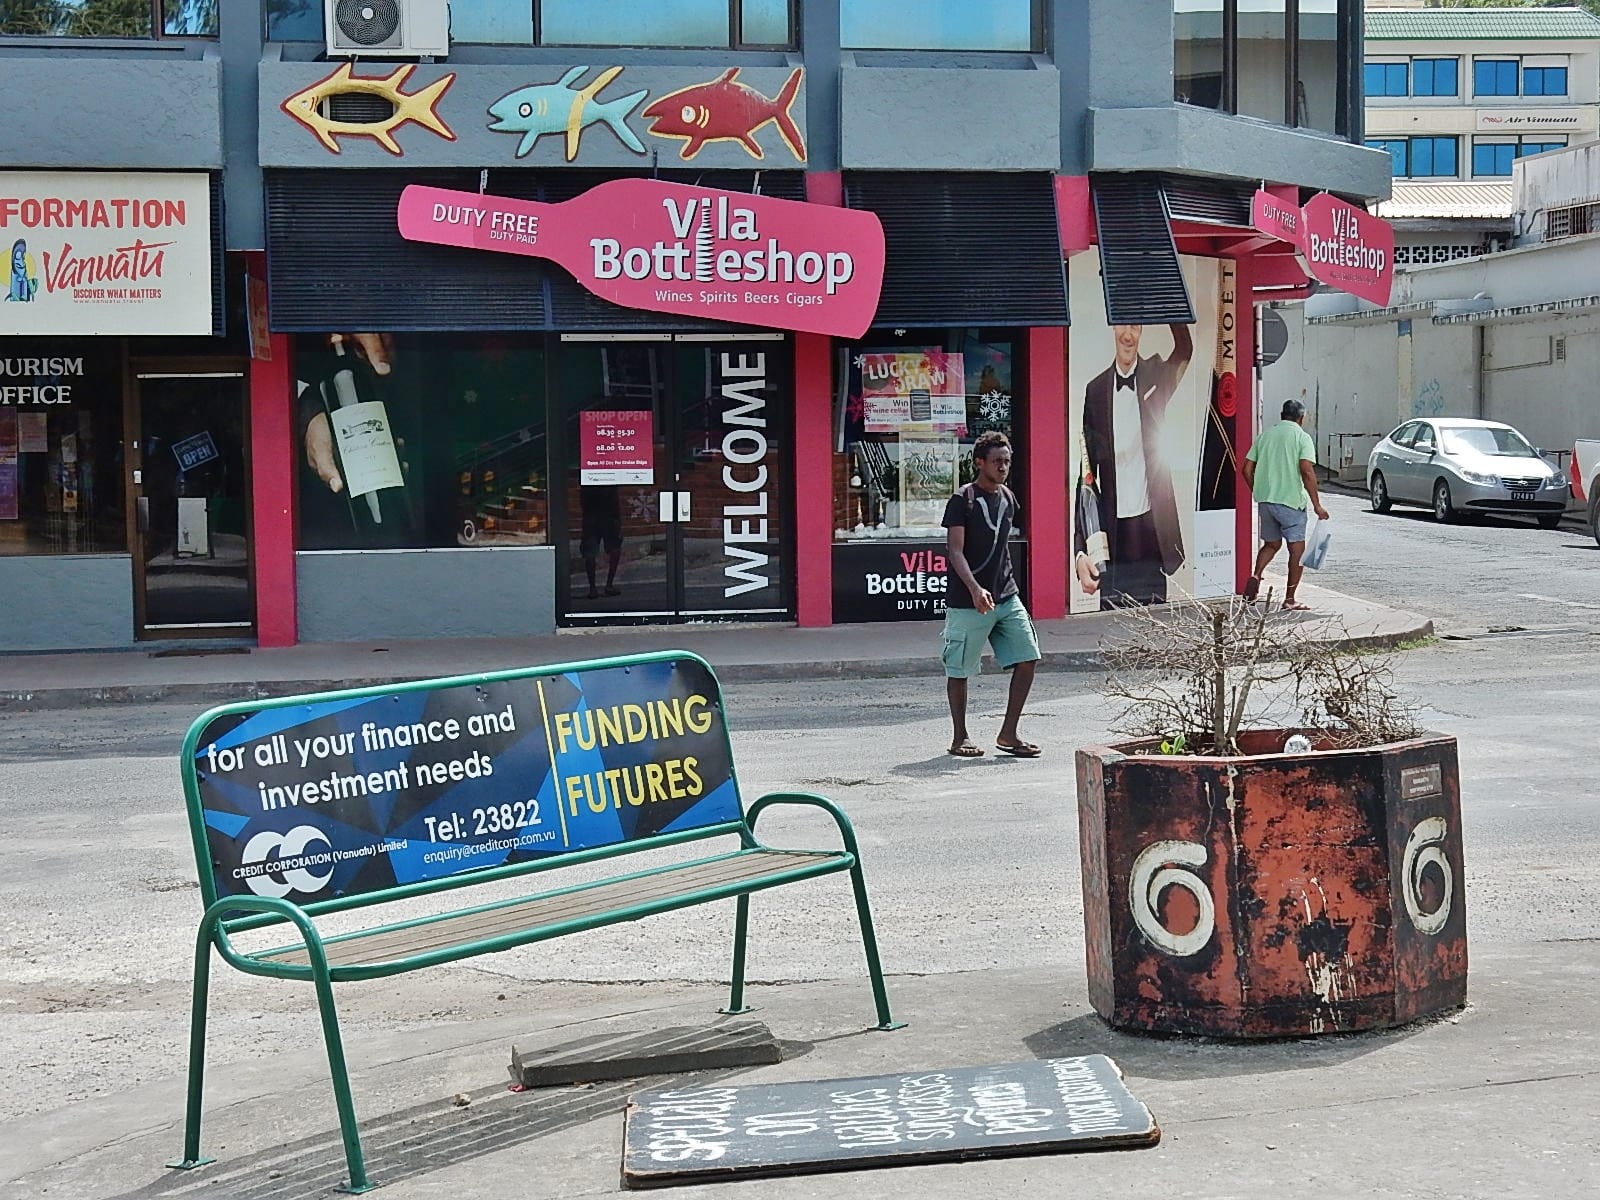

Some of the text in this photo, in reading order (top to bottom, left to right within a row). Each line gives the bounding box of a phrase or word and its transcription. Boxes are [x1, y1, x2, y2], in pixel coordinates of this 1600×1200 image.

[433, 203, 539, 234] DUTY FREE
[662, 195, 760, 241] Vila
[1263, 204, 1296, 229] DUTY FREE
[1331, 207, 1358, 239] Vila
[489, 230, 537, 245] DUTY PAID
[43, 238, 177, 293] Vanuatu
[590, 236, 854, 295] Bottleshop
[1311, 233, 1385, 278] Bottleshop
[73, 288, 162, 299] DISCOVER WHAT MATTERS
[655, 289, 823, 306] Wines Spirits Beers Cigars
[0, 357, 84, 376] URISM
[869, 360, 920, 380] LUCKY
[0, 385, 72, 404] FFICE
[893, 399, 909, 407] Win
[585, 411, 648, 421] SHOP OPEN
[596, 429, 614, 437] 08.30
[721, 352, 769, 598] WELCOME
[900, 551, 947, 573] Vila
[897, 600, 928, 610] DUTY
[207, 704, 516, 773] for all your finance and
[554, 694, 713, 754] FUNDING
[258, 750, 493, 811] investment needs
[565, 756, 704, 817] FUTURES
[424, 799, 542, 844] Tel: 23822
[232, 839, 408, 880] CREDIT CORPORATION (Vanuatu) Limited
[424, 829, 556, 865] enquiry@creditcorp.com.vu
[1402, 816, 1453, 936] 6
[1128, 839, 1215, 957] 6
